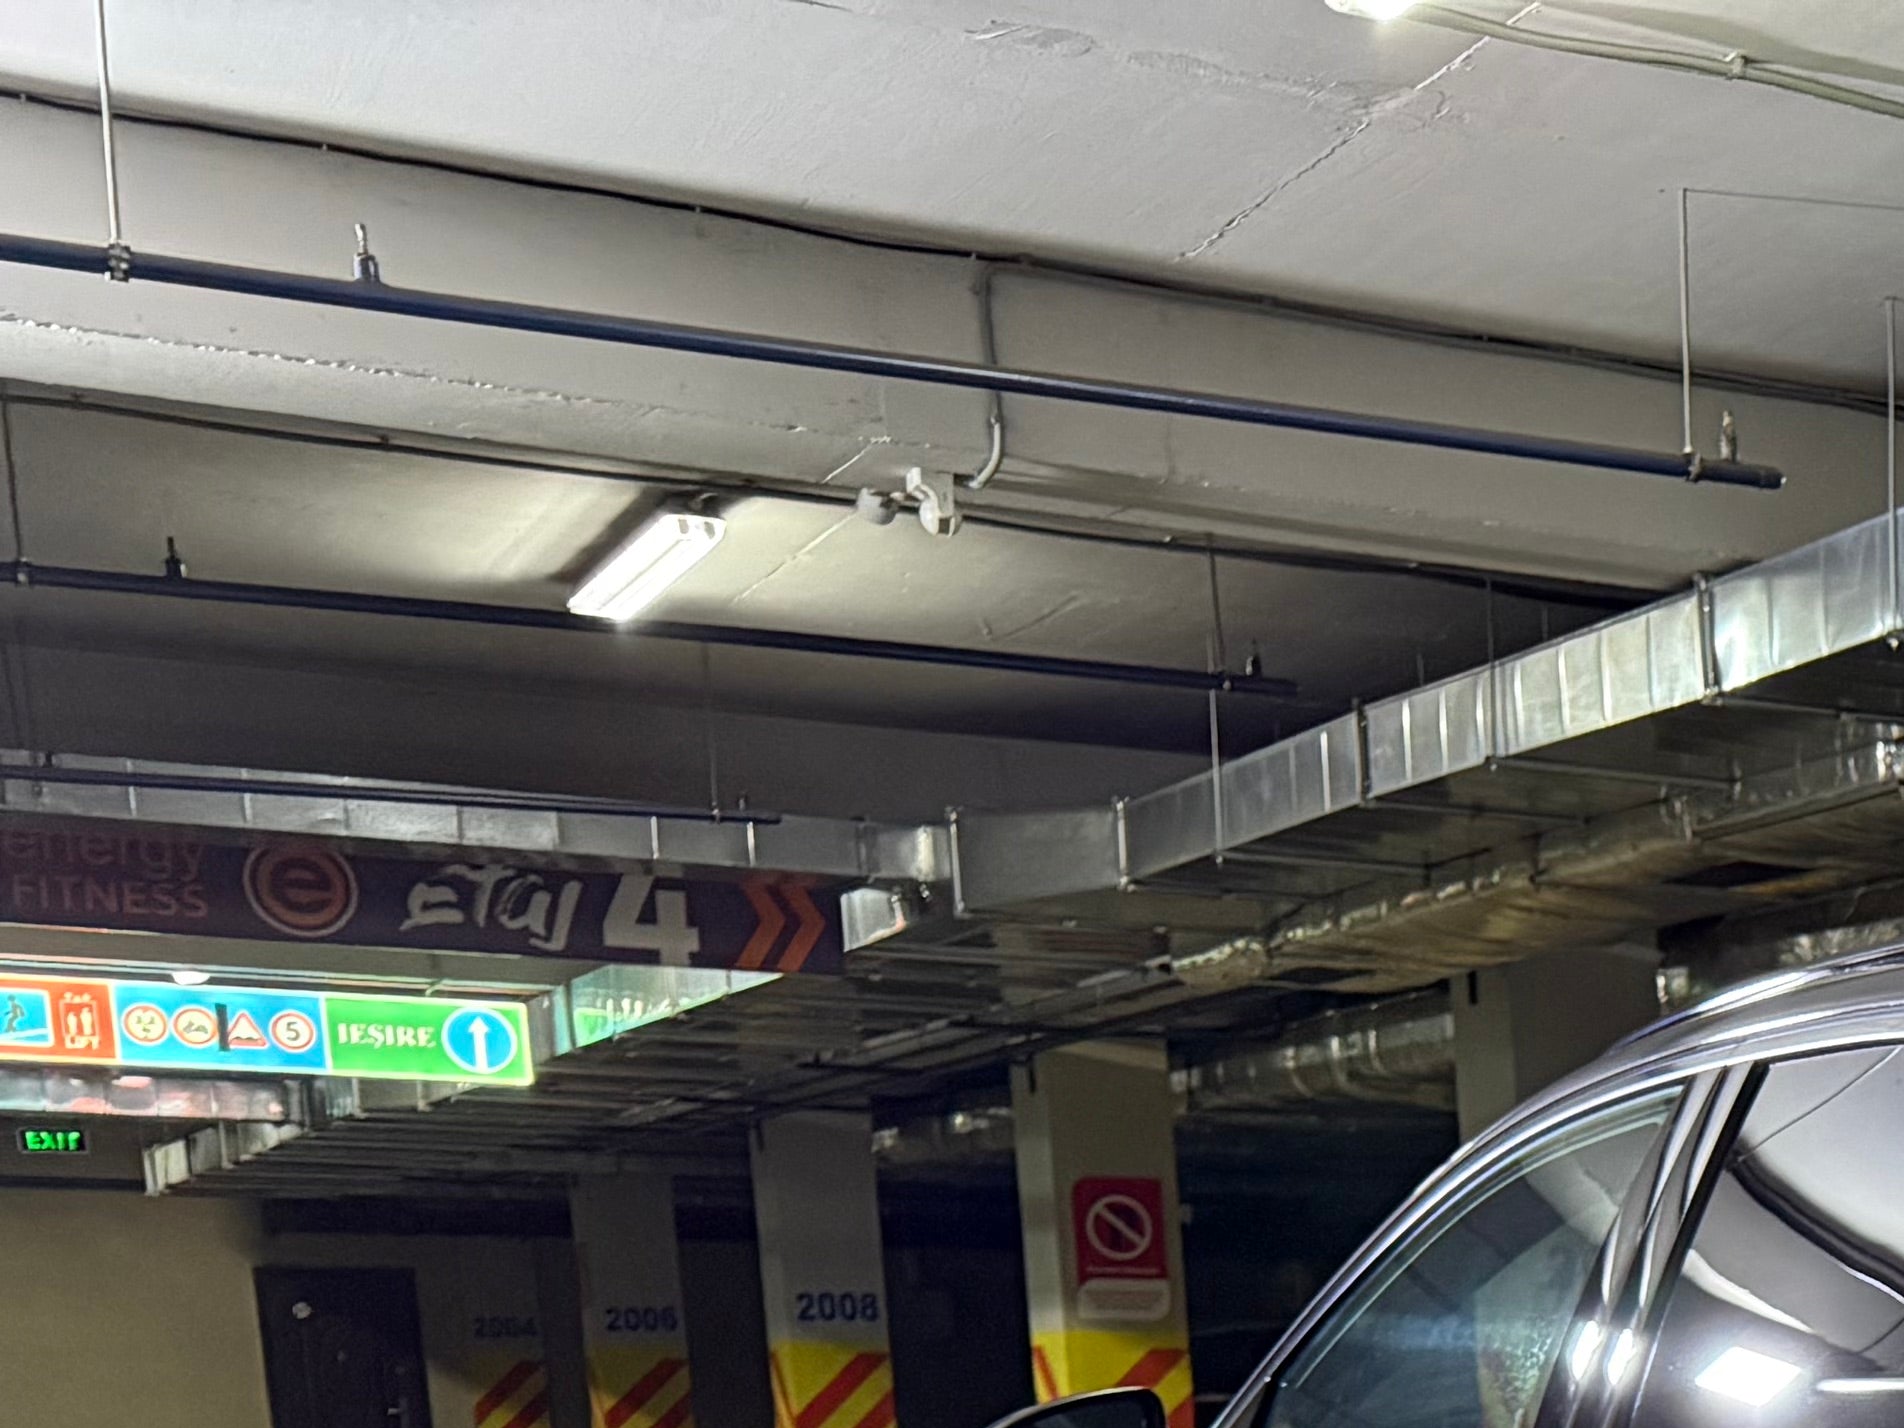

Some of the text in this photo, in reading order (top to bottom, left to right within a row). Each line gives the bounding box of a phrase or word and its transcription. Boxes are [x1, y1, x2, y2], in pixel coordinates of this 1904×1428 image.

[13, 874, 209, 917] FITNESS
[602, 862, 700, 966] 4
[285, 1021, 300, 1041] 5
[25, 1130, 80, 1150] EXIT
[606, 1307, 679, 1332] 2006
[796, 1292, 880, 1323] 2008
